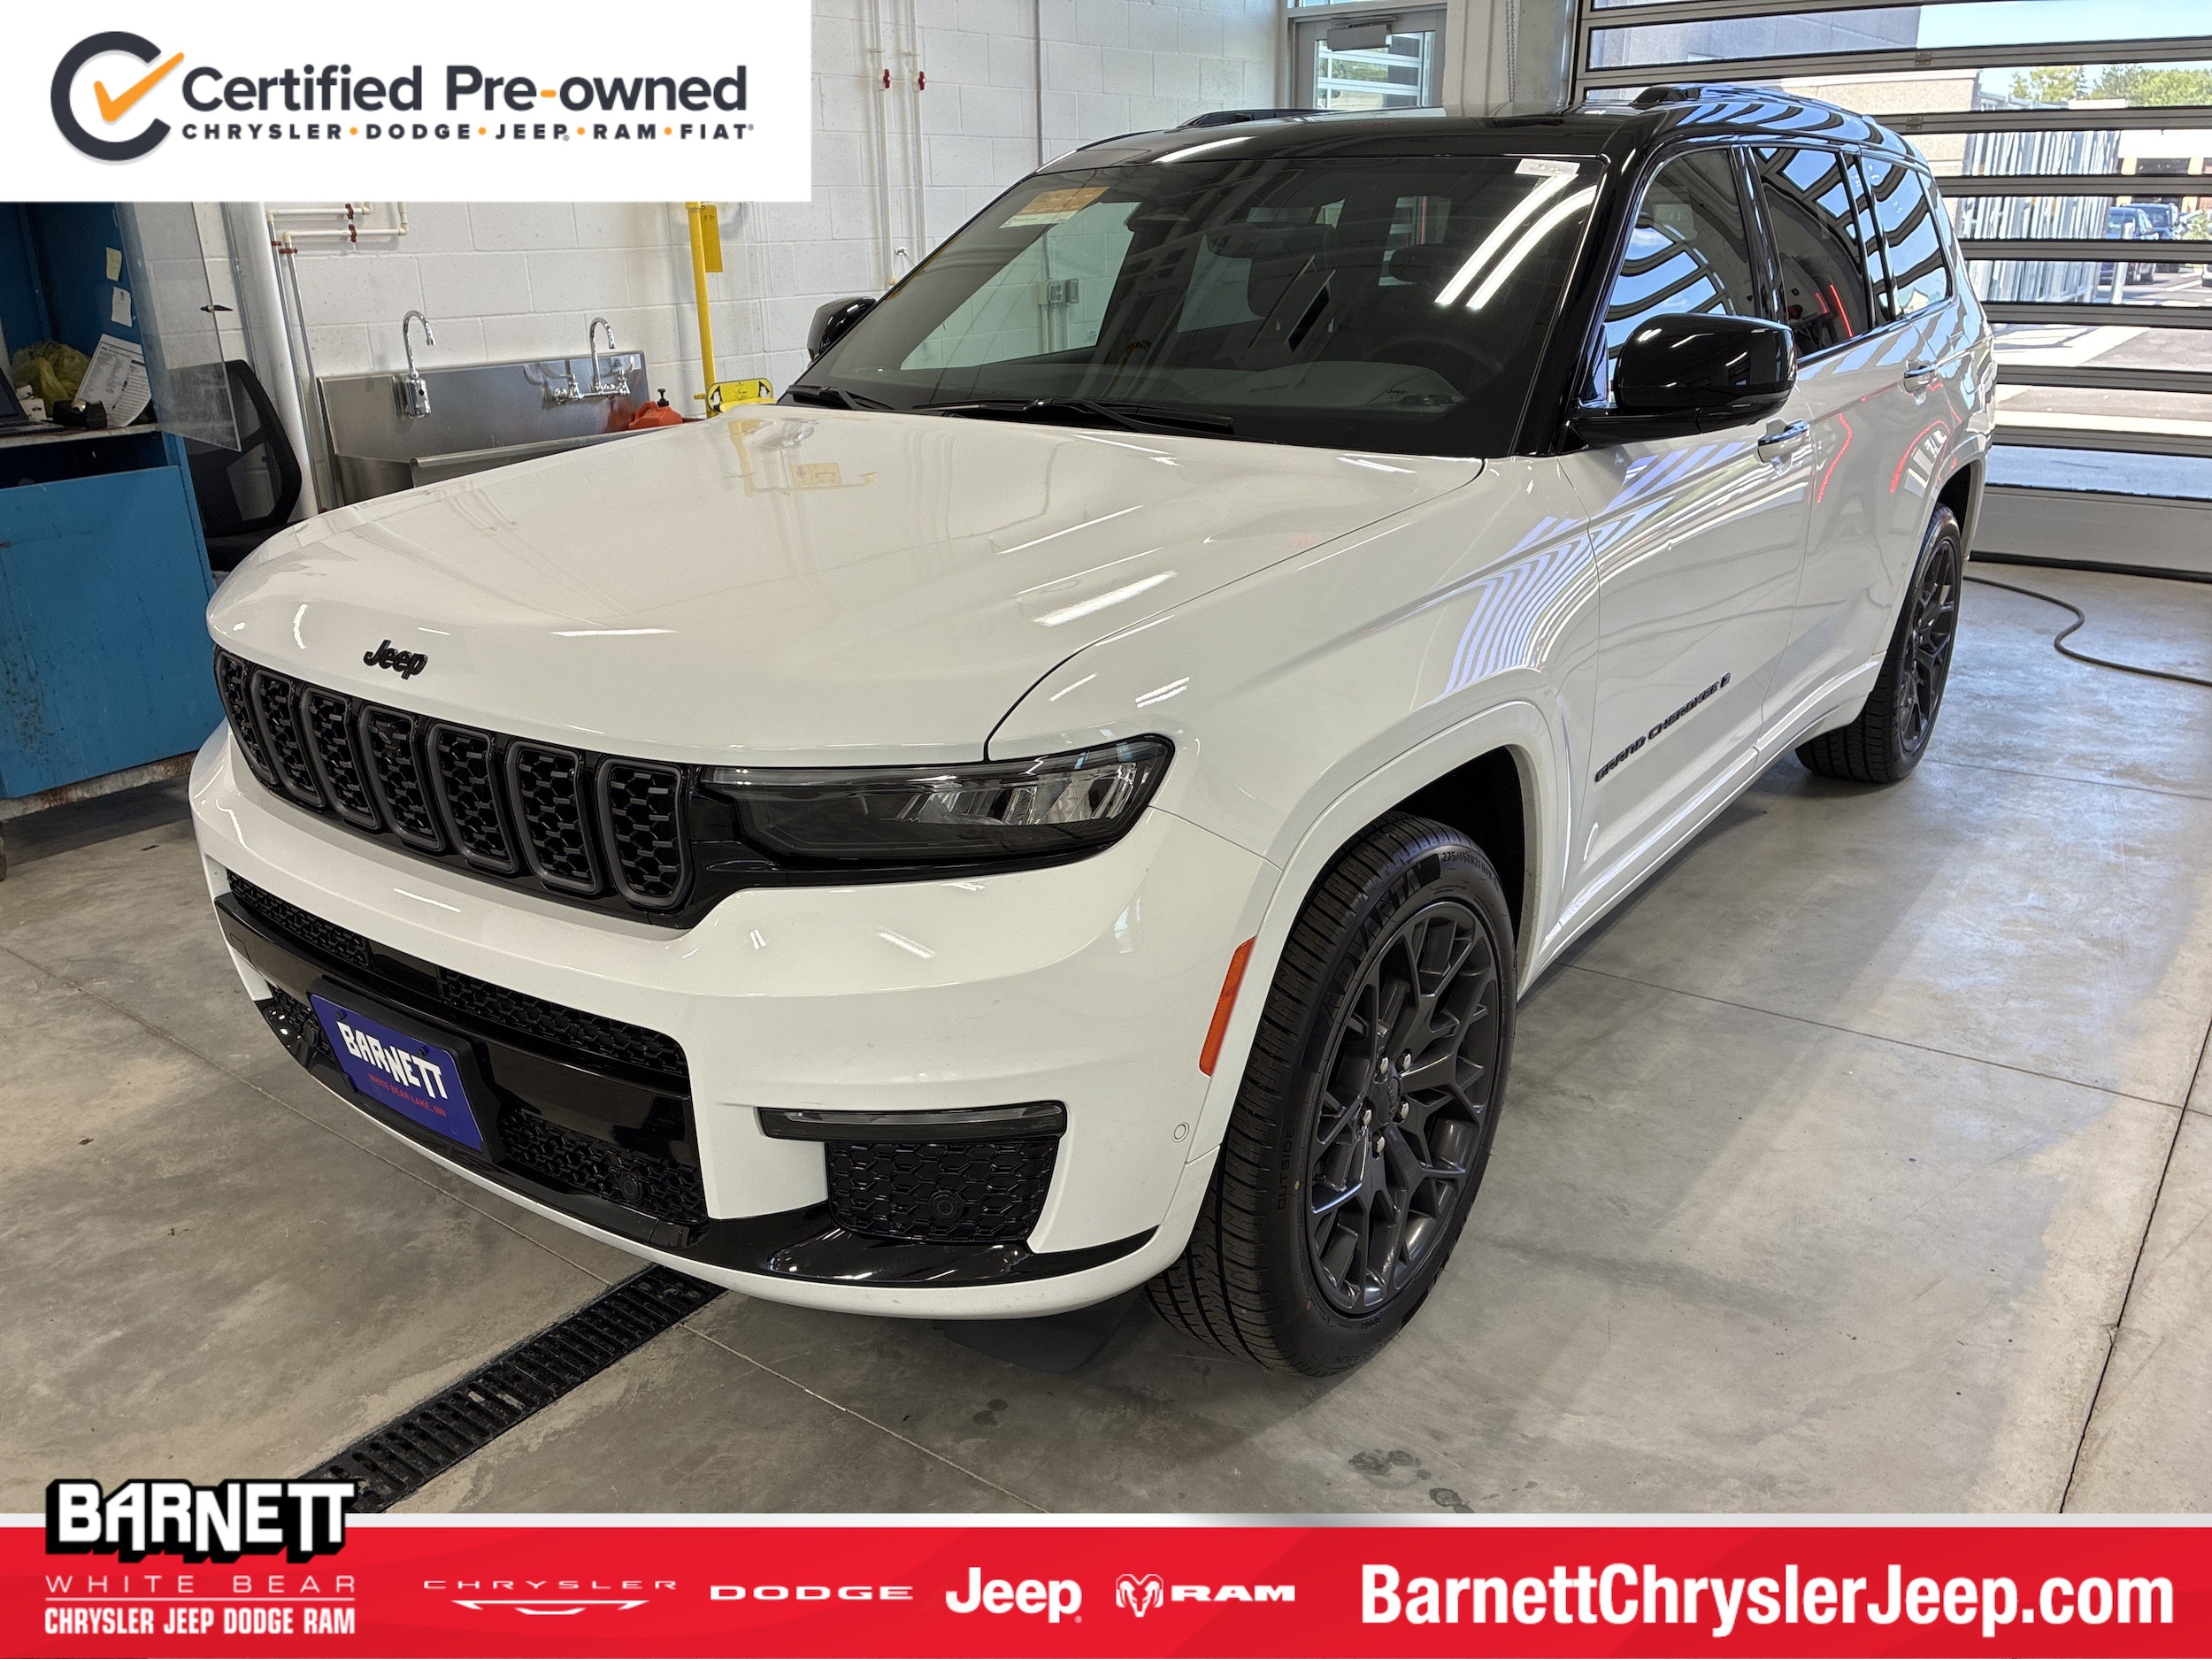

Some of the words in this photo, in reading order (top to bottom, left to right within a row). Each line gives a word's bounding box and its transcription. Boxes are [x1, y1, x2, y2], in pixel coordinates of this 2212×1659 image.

[363, 639, 428, 680] Jeep
[1594, 735, 1647, 782] GRAND
[336, 1020, 449, 1100] BARNETT
[1278, 1127, 1295, 1210] OUTSIDE
